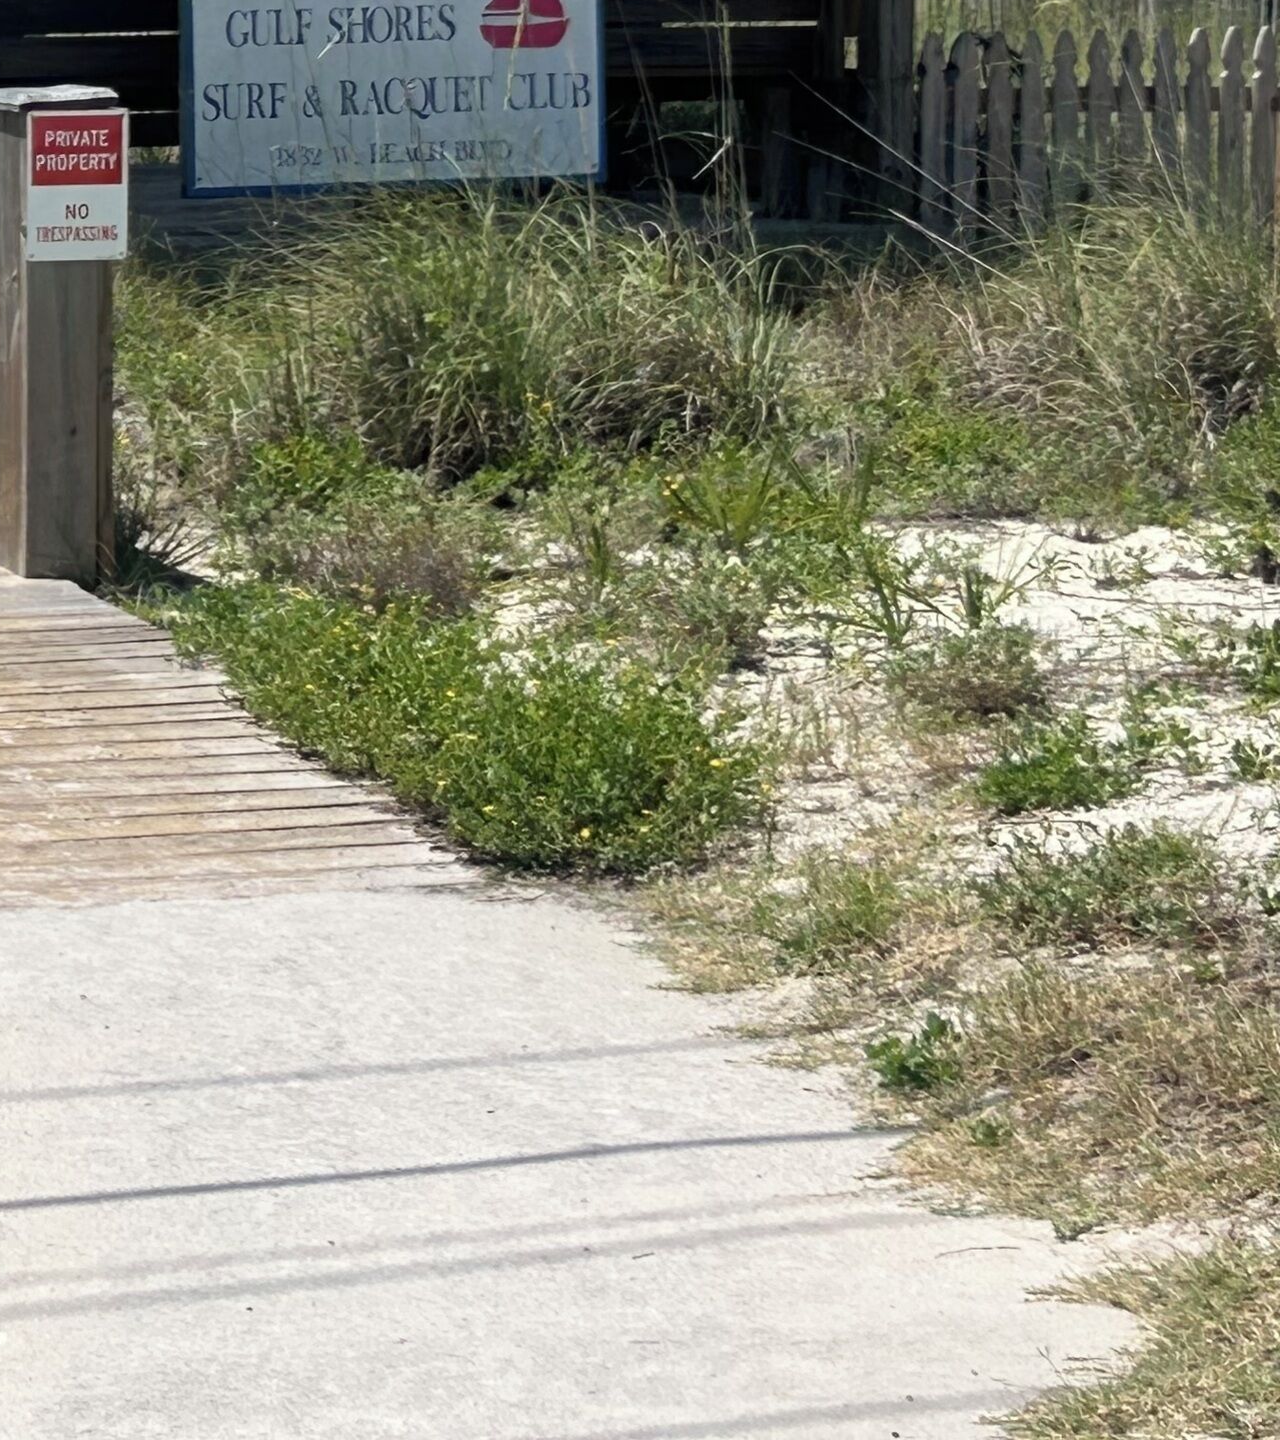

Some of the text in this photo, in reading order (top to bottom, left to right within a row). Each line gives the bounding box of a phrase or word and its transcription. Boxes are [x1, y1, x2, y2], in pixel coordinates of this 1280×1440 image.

[226, 4, 456, 47] GULF SHORES
[202, 72, 590, 122] SURF & RACQUET CLUB
[44, 129, 109, 148] PRIVATE
[36, 152, 118, 172] PROPERTY
[65, 203, 90, 220] NO
[37, 224, 119, 243] TRESPASSING
